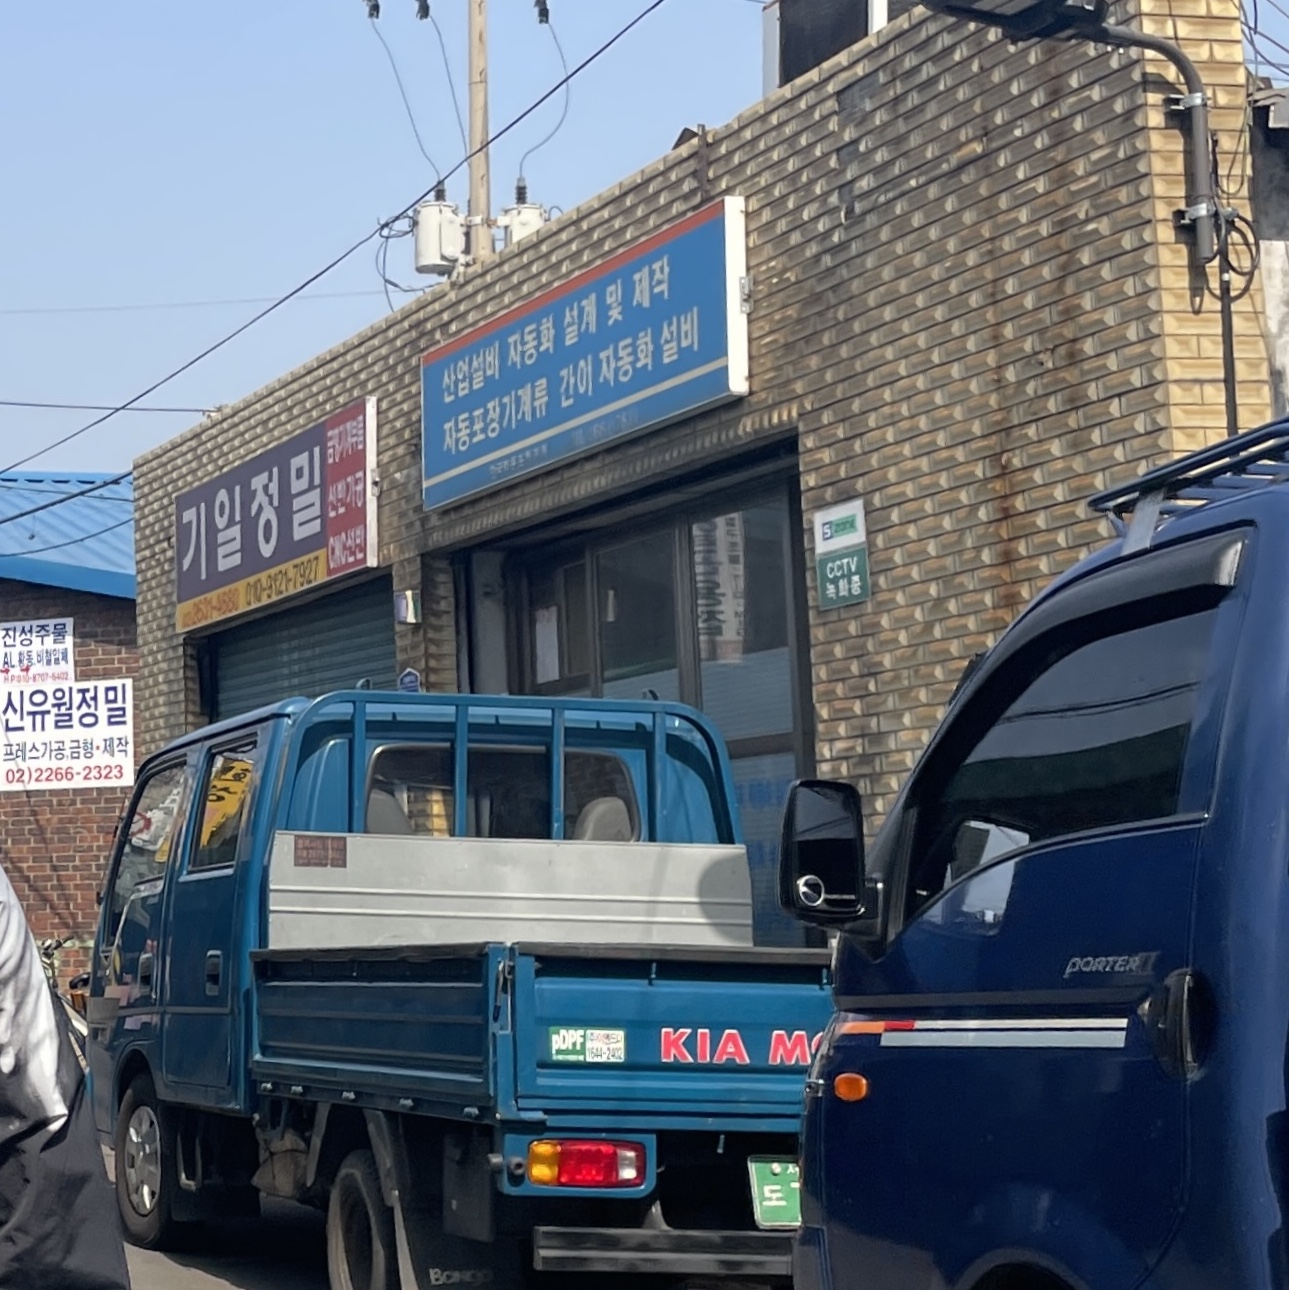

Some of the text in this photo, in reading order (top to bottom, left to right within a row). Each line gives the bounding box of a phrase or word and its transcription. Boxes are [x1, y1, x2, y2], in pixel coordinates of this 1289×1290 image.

[442, 254, 670, 404] 산업설비 자동화 설계 및 제작
[443, 377, 549, 454] 자동포장기계류
[559, 355, 593, 408] 간이
[599, 327, 653, 387] 자동화
[661, 306, 699, 364] 설비
[182, 446, 322, 580] 기일정밀
[826, 556, 858, 578] CCTV
[826, 574, 861, 600] 녹화중
[2, 622, 68, 648] 진성주물
[2, 683, 128, 733] 신유월정밀
[5, 765, 124, 784] 02)2266-2323
[660, 1027, 822, 1066] KIA M
